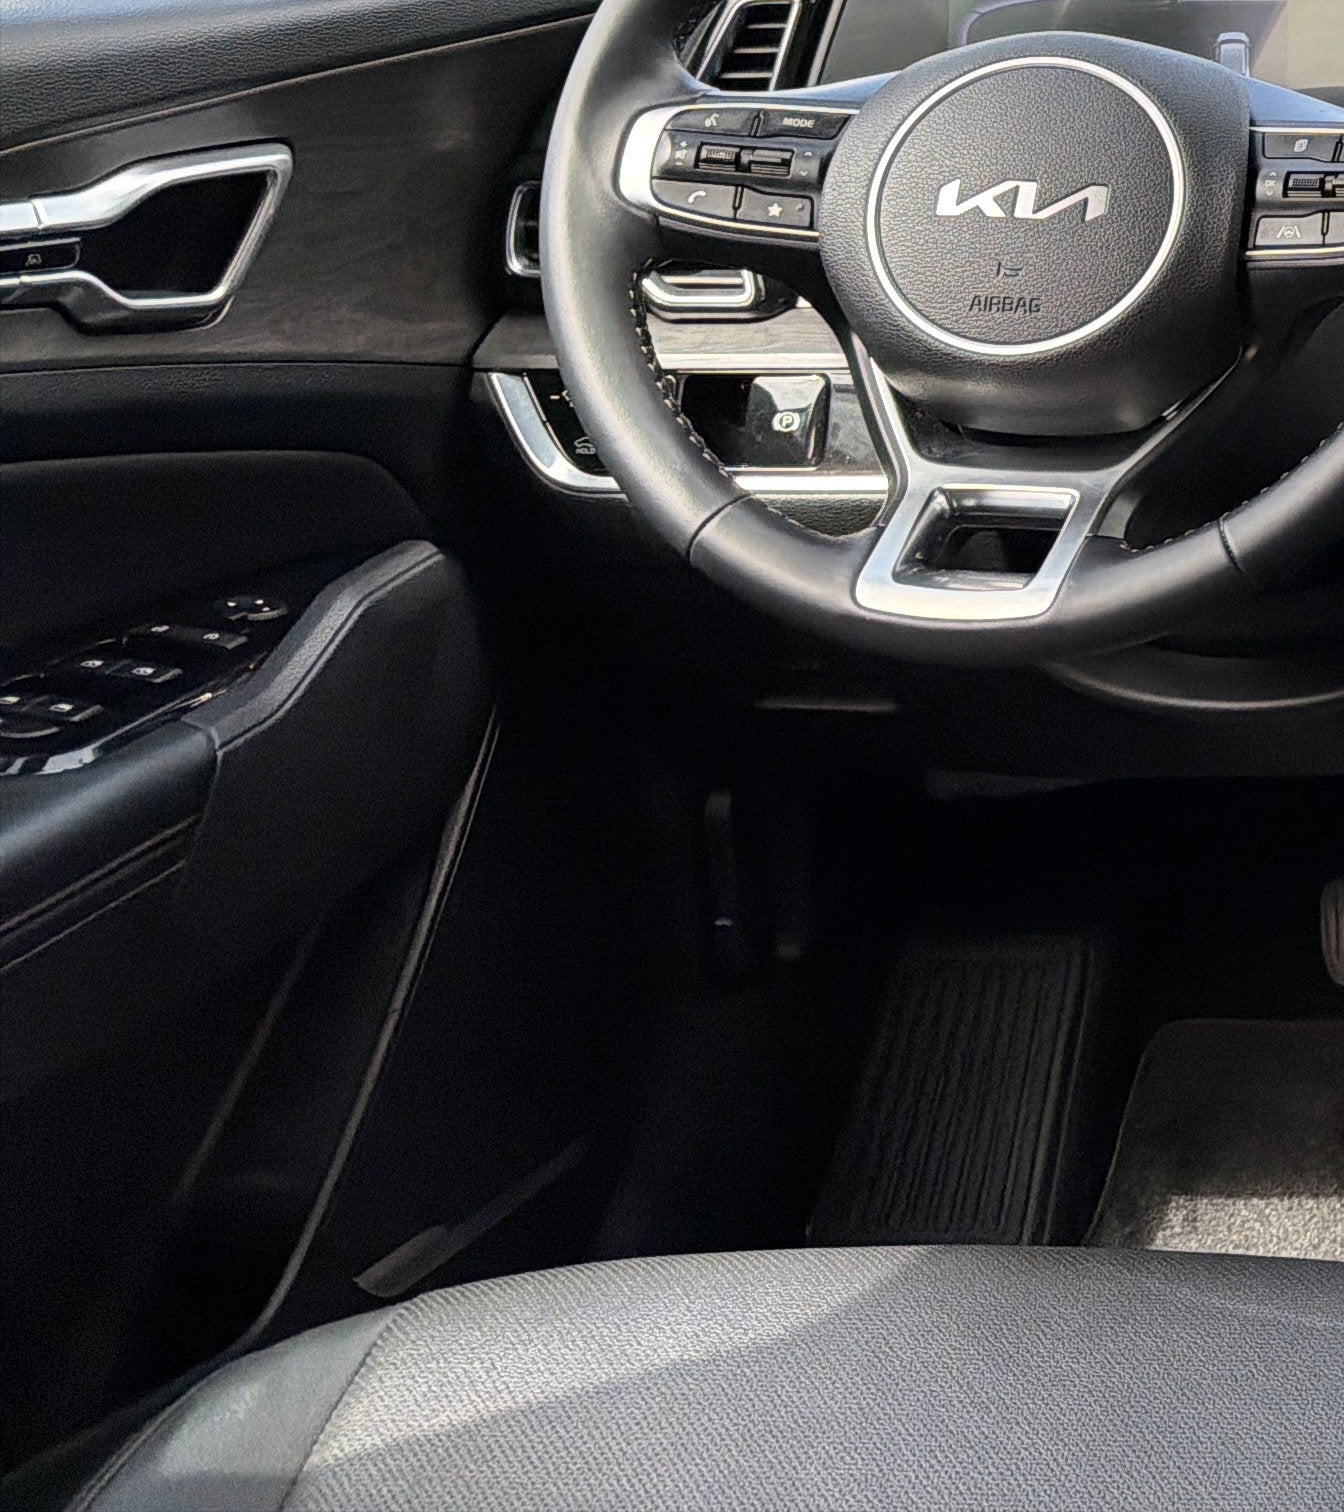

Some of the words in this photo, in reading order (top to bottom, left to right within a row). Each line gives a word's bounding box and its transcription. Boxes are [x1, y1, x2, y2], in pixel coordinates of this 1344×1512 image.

[782, 117, 816, 129] MODE
[1264, 179, 1277, 188] OK
[935, 178, 1111, 222] KIA
[968, 294, 1042, 315] AIRBAG
